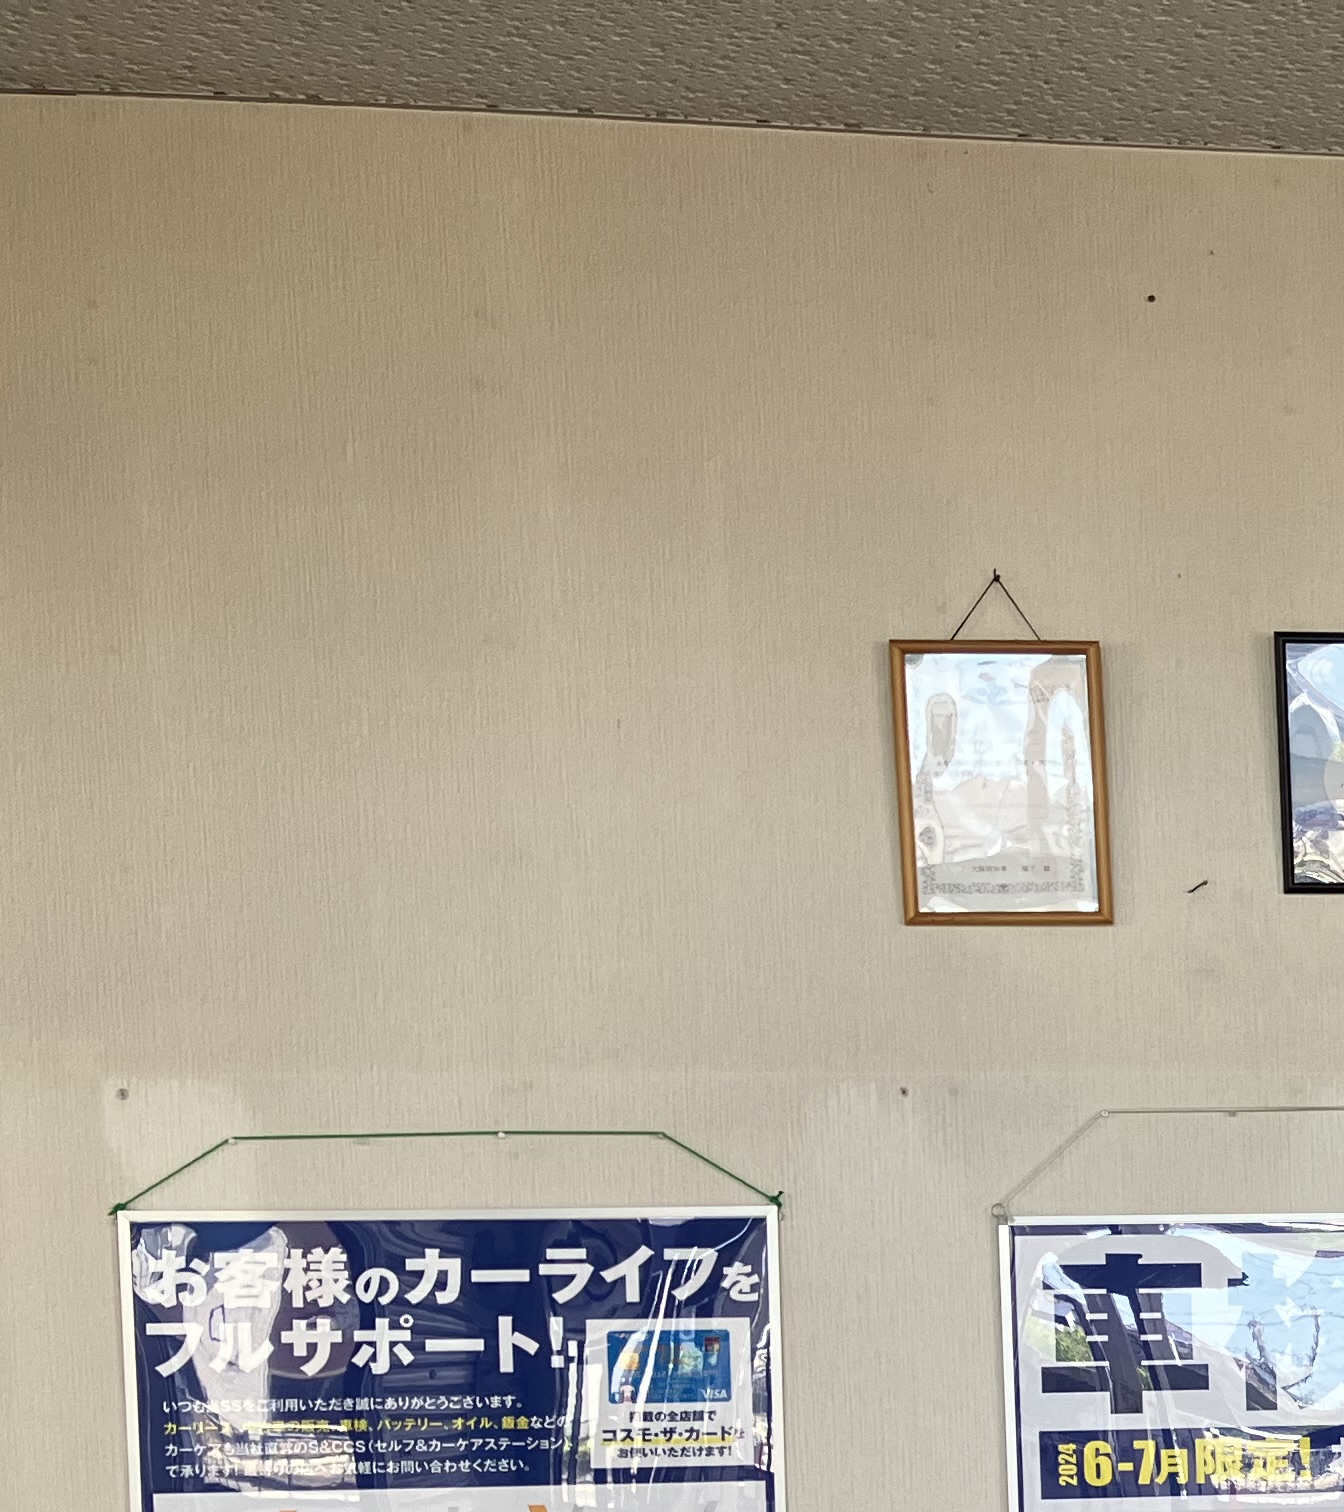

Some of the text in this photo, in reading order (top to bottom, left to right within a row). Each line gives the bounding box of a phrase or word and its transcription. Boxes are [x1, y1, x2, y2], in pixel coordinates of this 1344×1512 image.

[144, 1244, 760, 1308] お客様のカーライフを
[145, 1315, 567, 1378] フルサポート!
[702, 1389, 728, 1399] VISA
[1057, 1443, 1077, 1486] 2024
